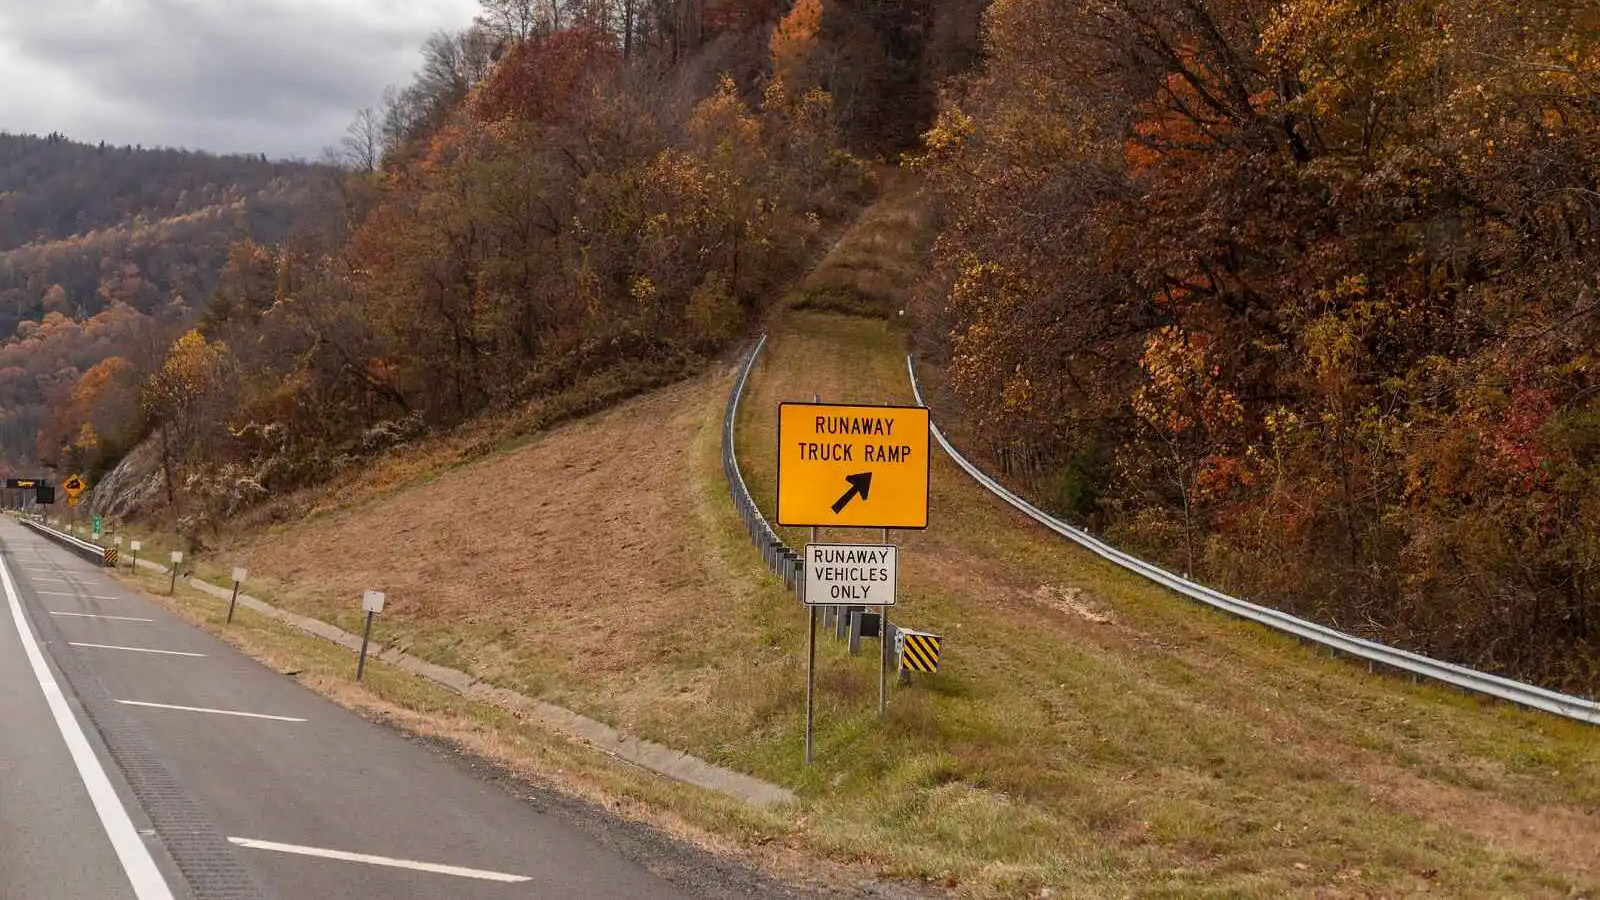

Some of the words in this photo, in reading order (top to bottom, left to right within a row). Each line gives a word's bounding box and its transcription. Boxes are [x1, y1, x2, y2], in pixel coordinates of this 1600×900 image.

[815, 416, 894, 435] RUNAWAY
[798, 442, 852, 461] TRUCK
[864, 445, 911, 463] RAMP
[814, 549, 888, 564] RUNAWAY
[815, 567, 888, 581] VEHICLES
[830, 585, 871, 598] ONLY
